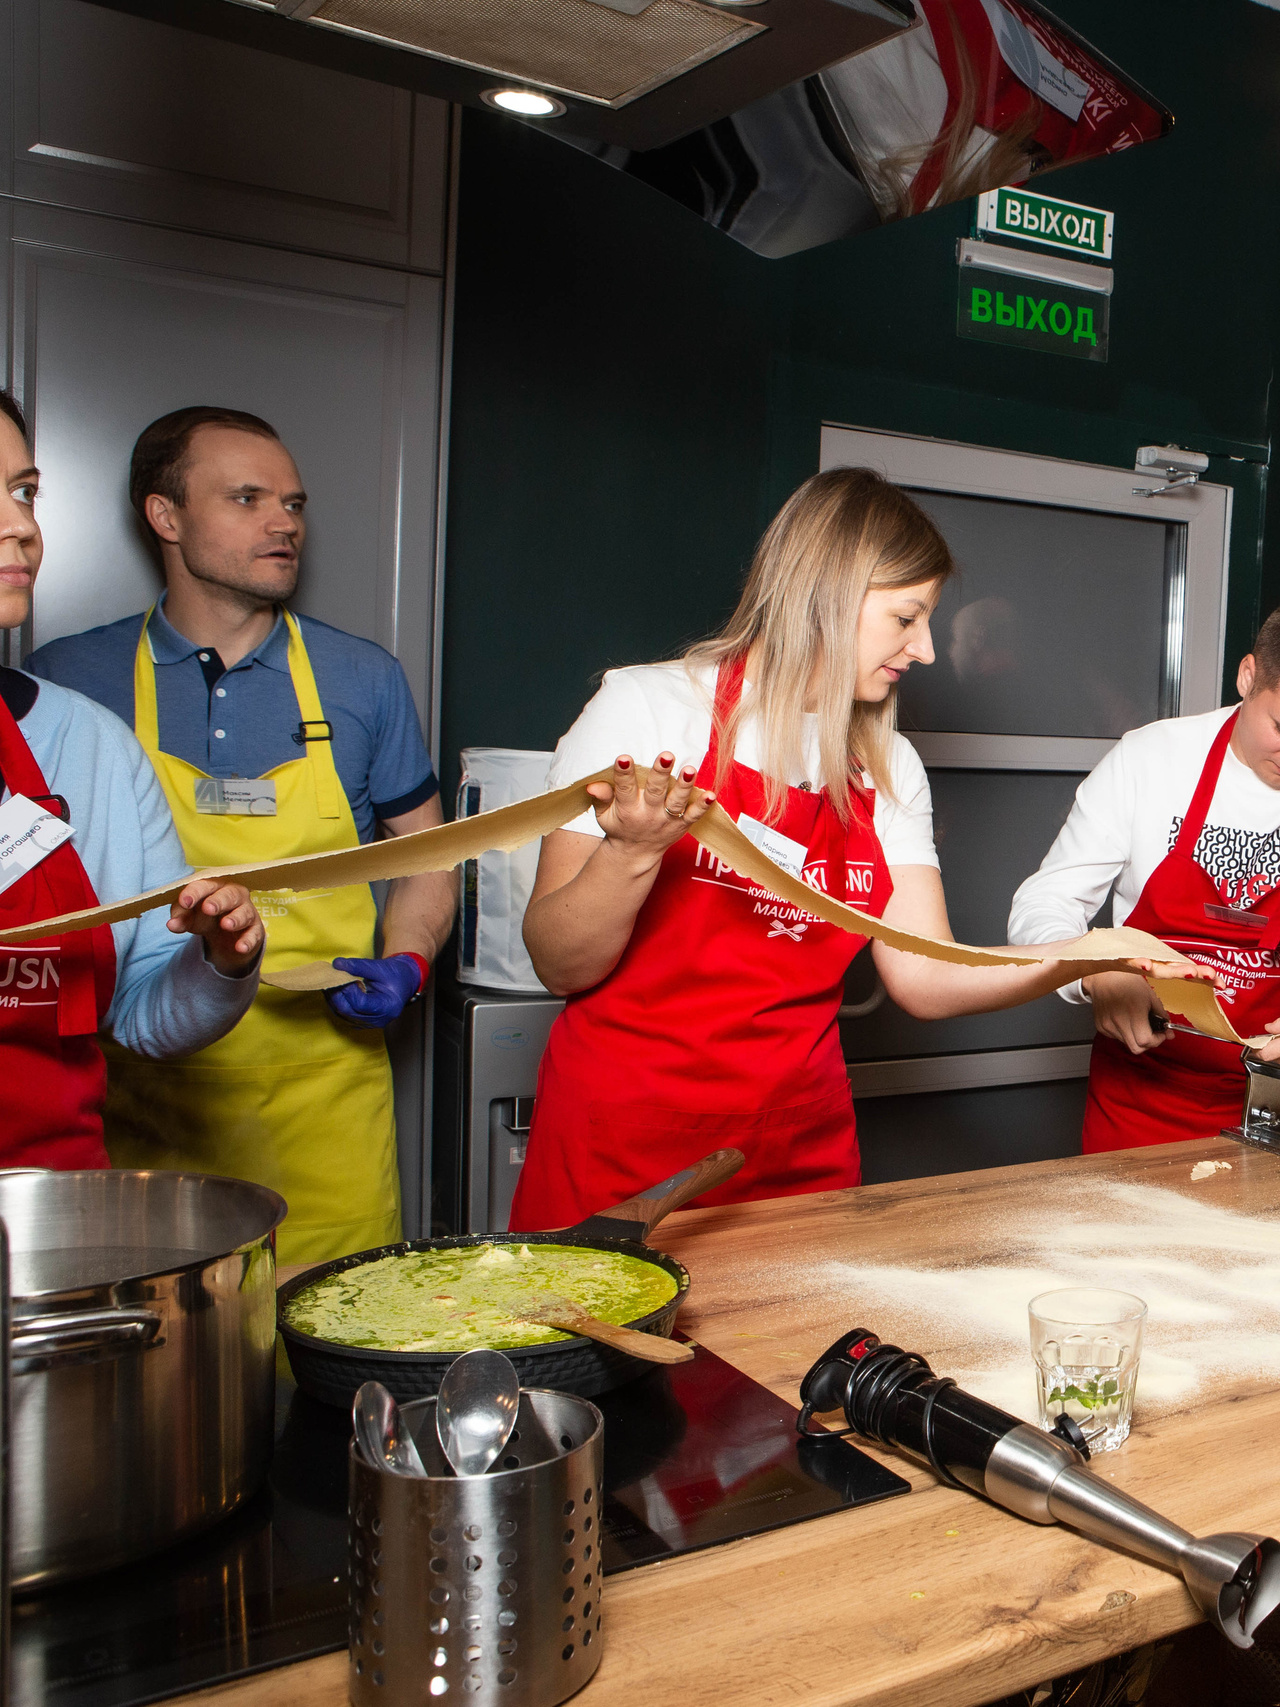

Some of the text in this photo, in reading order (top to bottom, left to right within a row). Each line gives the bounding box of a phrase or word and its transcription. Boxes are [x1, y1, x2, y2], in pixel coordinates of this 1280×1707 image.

[1004, 198, 1096, 248] ВЫХОД
[970, 286, 1098, 347] ВЫХОД
[0, 824, 42, 861] оргашева
[256, 906, 289, 918] FELD
[260, 895, 297, 906] СТУДИЯ
[1236, 968, 1267, 979] СТУДИЯ
